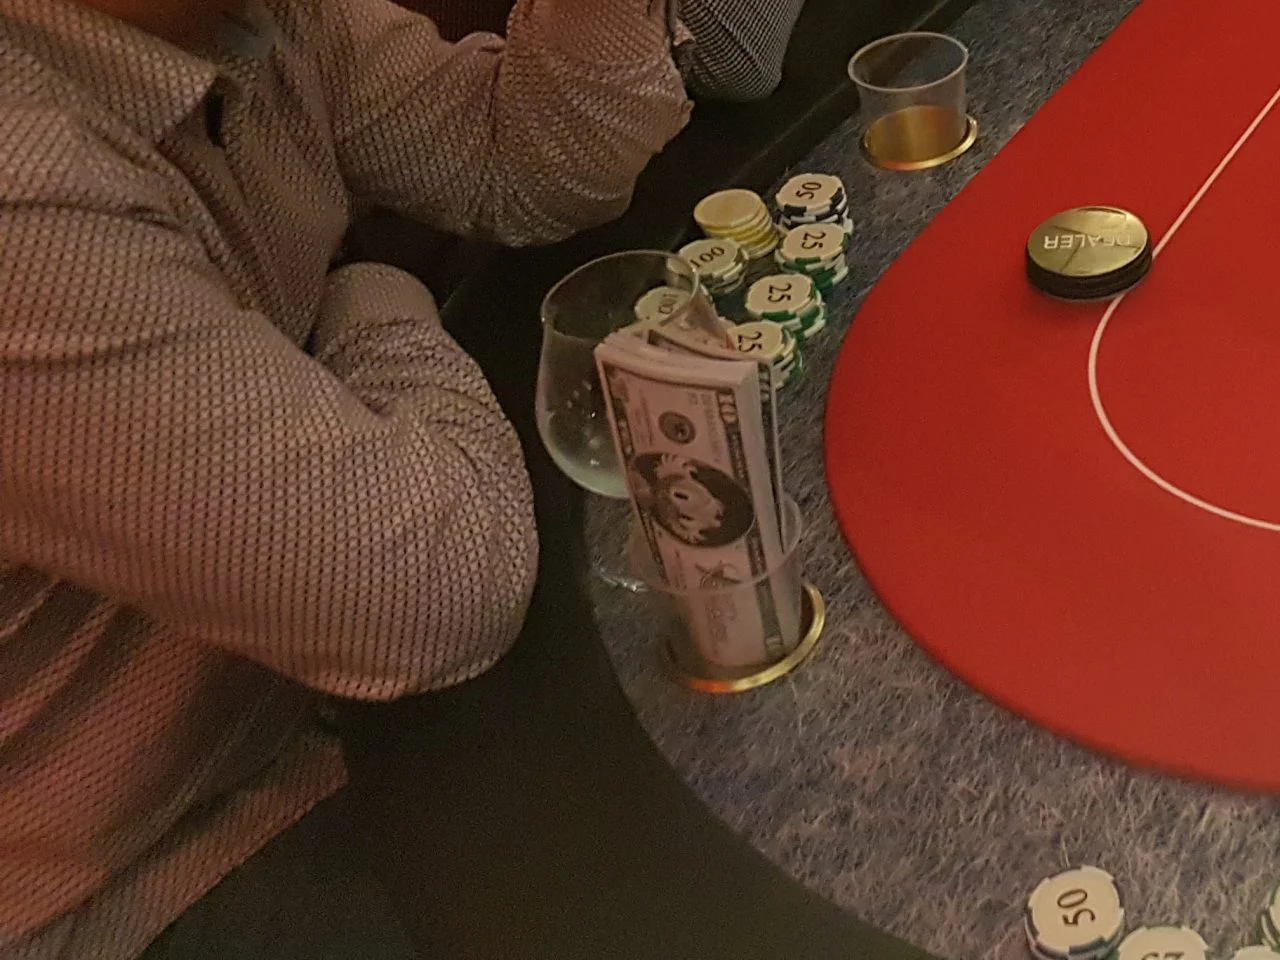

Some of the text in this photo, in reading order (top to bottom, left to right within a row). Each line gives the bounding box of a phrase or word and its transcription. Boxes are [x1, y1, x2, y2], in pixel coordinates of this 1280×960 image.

[795, 181, 822, 200] 50
[801, 231, 826, 250] 25
[1044, 234, 1131, 249] DEALER
[690, 246, 725, 268] 100
[767, 283, 792, 304] 25
[737, 331, 763, 353] 25
[1057, 888, 1096, 927] 50
